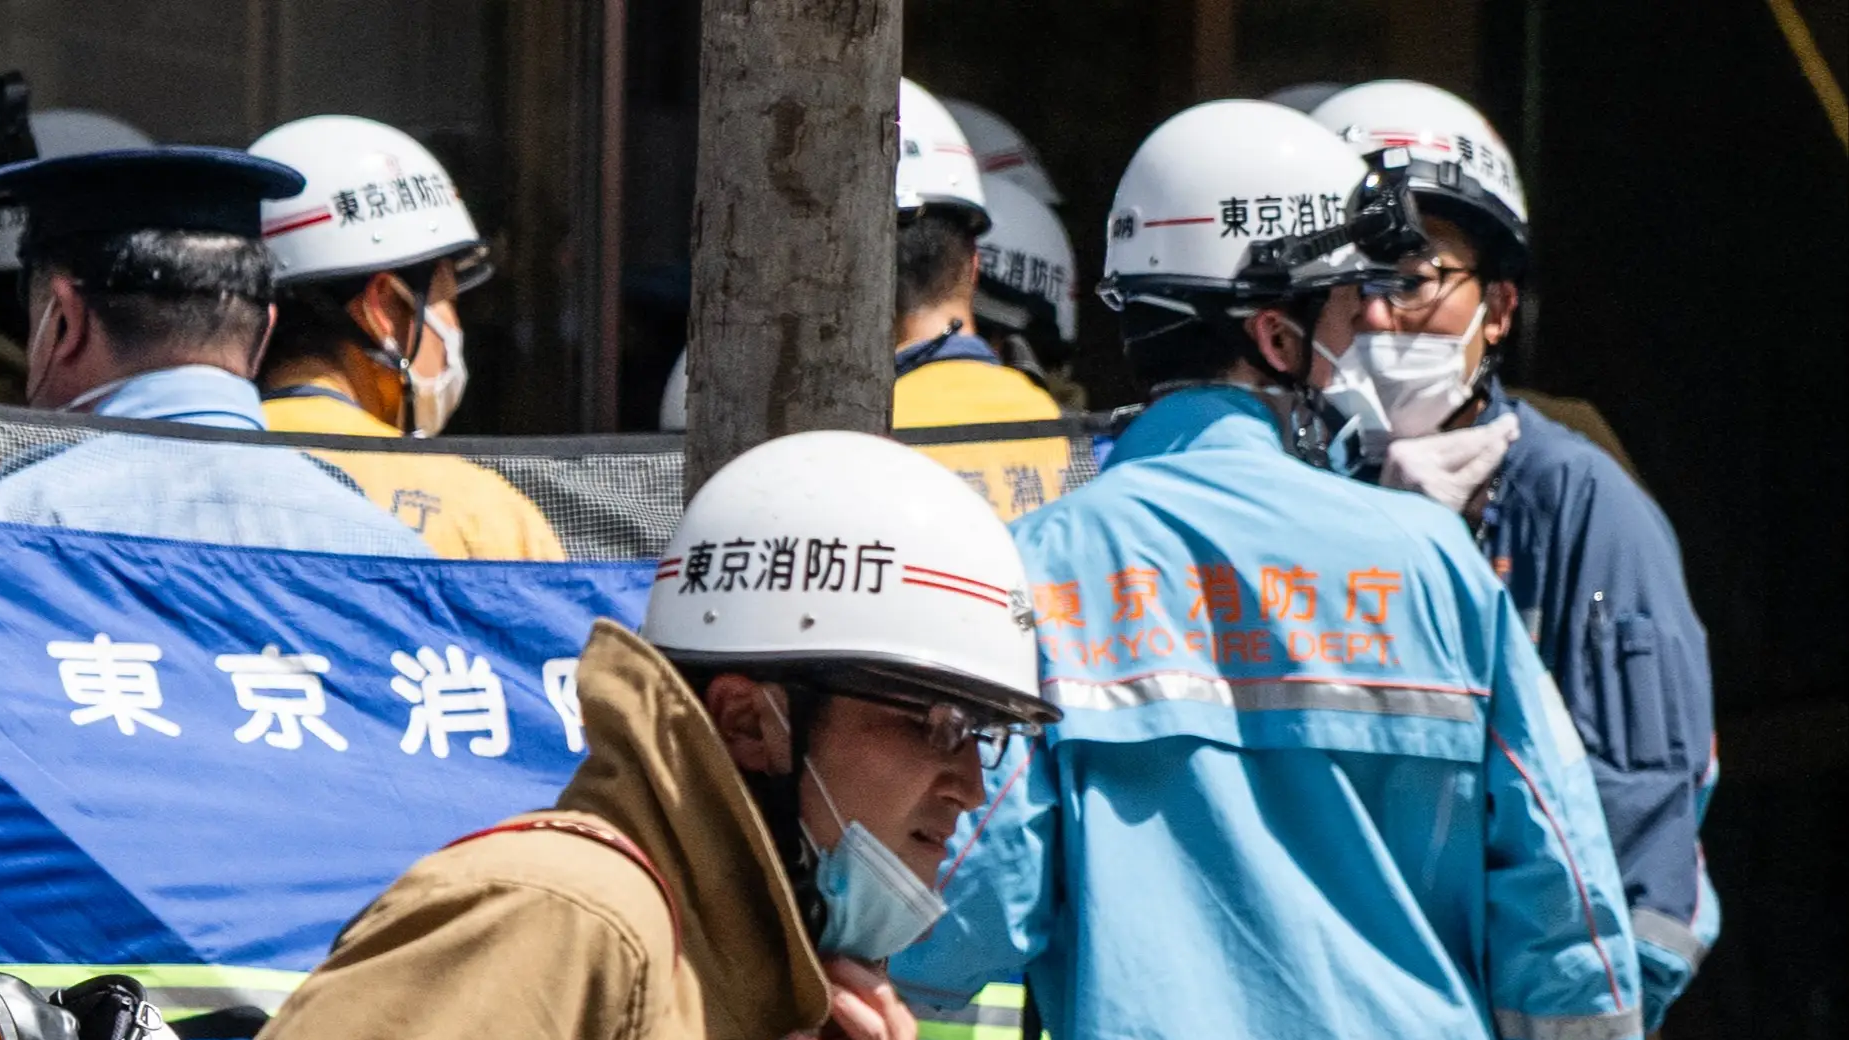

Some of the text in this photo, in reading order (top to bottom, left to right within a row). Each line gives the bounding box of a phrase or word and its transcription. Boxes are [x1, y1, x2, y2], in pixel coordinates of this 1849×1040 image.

[679, 536, 896, 594] 東京消防庁
[1030, 564, 1402, 629] 東京消防庁
[1039, 627, 1401, 668] TOKYO FIRE DEPT.
